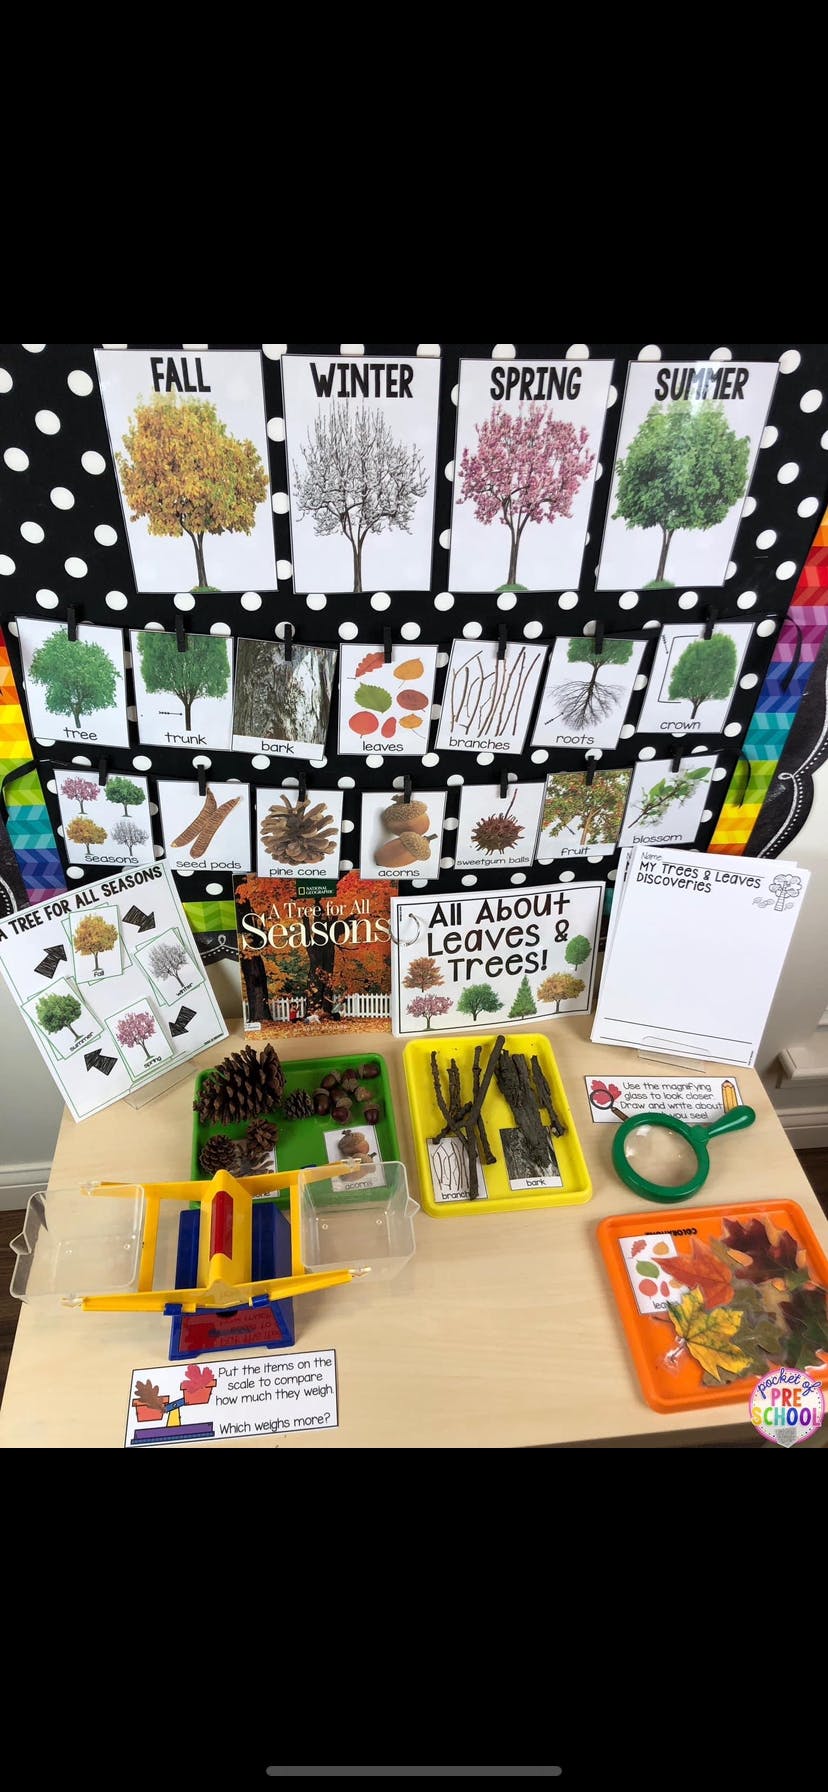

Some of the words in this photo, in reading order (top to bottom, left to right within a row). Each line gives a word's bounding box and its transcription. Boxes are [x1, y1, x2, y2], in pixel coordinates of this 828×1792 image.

[151, 357, 211, 393] FALL
[310, 363, 414, 398] WINTER
[490, 366, 582, 401] SPRING
[655, 367, 749, 401] SUMMER
[660, 720, 701, 731] crown
[63, 727, 98, 741] tree
[165, 732, 208, 746] trunk
[556, 733, 594, 745] roots
[261, 741, 294, 754] bark
[362, 740, 403, 752] leaves
[449, 736, 510, 750] branches
[633, 834, 682, 844] blossom
[561, 847, 590, 856] fruit
[640, 852, 662, 860] Name
[84, 854, 139, 864] seasons
[176, 859, 206, 869] seed
[210, 859, 241, 870] pods
[457, 858, 506, 866] sweetgum
[269, 868, 293, 876] pine
[297, 868, 327, 876] cone
[378, 868, 420, 877] acorns
[662, 863, 699, 879] Trees
[702, 870, 711, 880] &
[714, 872, 761, 889] Leaves
[8, 910, 44, 935] TREE
[43, 899, 72, 921] FOR
[75, 889, 100, 909] ALL
[101, 866, 163, 897] SEASONS
[269, 904, 280, 919] A
[284, 902, 322, 919] Tree
[326, 901, 346, 916] for
[350, 899, 370, 914] All
[429, 902, 462, 928] All
[475, 893, 570, 925] About
[242, 913, 391, 950] Seasons
[427, 924, 540, 957] Leaves
[554, 919, 570, 943] &
[448, 950, 548, 982] Trees!
[176, 983, 193, 997] winter
[69, 1032, 94, 1052] summer
[144, 1056, 162, 1068] spring
[623, 1082, 641, 1090] Use
[662, 1082, 712, 1092] magnifying
[624, 1092, 648, 1100] glass
[620, 1101, 645, 1109] Draw
[345, 1181, 373, 1190] acorns
[525, 1178, 547, 1187] bark
[441, 1191, 479, 1200] branch
[219, 1366, 239, 1377] Put
[242, 1365, 261, 1375] the
[263, 1362, 294, 1373] items
[297, 1360, 311, 1369] on
[314, 1357, 332, 1367] the
[227, 1378, 255, 1390] scale
[259, 1377, 271, 1387] to
[274, 1373, 323, 1386] compare
[216, 1395, 238, 1406] how
[241, 1390, 272, 1403] much
[275, 1388, 300, 1400] they
[220, 1420, 251, 1434] Which
[254, 1418, 290, 1432] weighs
[293, 1412, 331, 1427] more?
